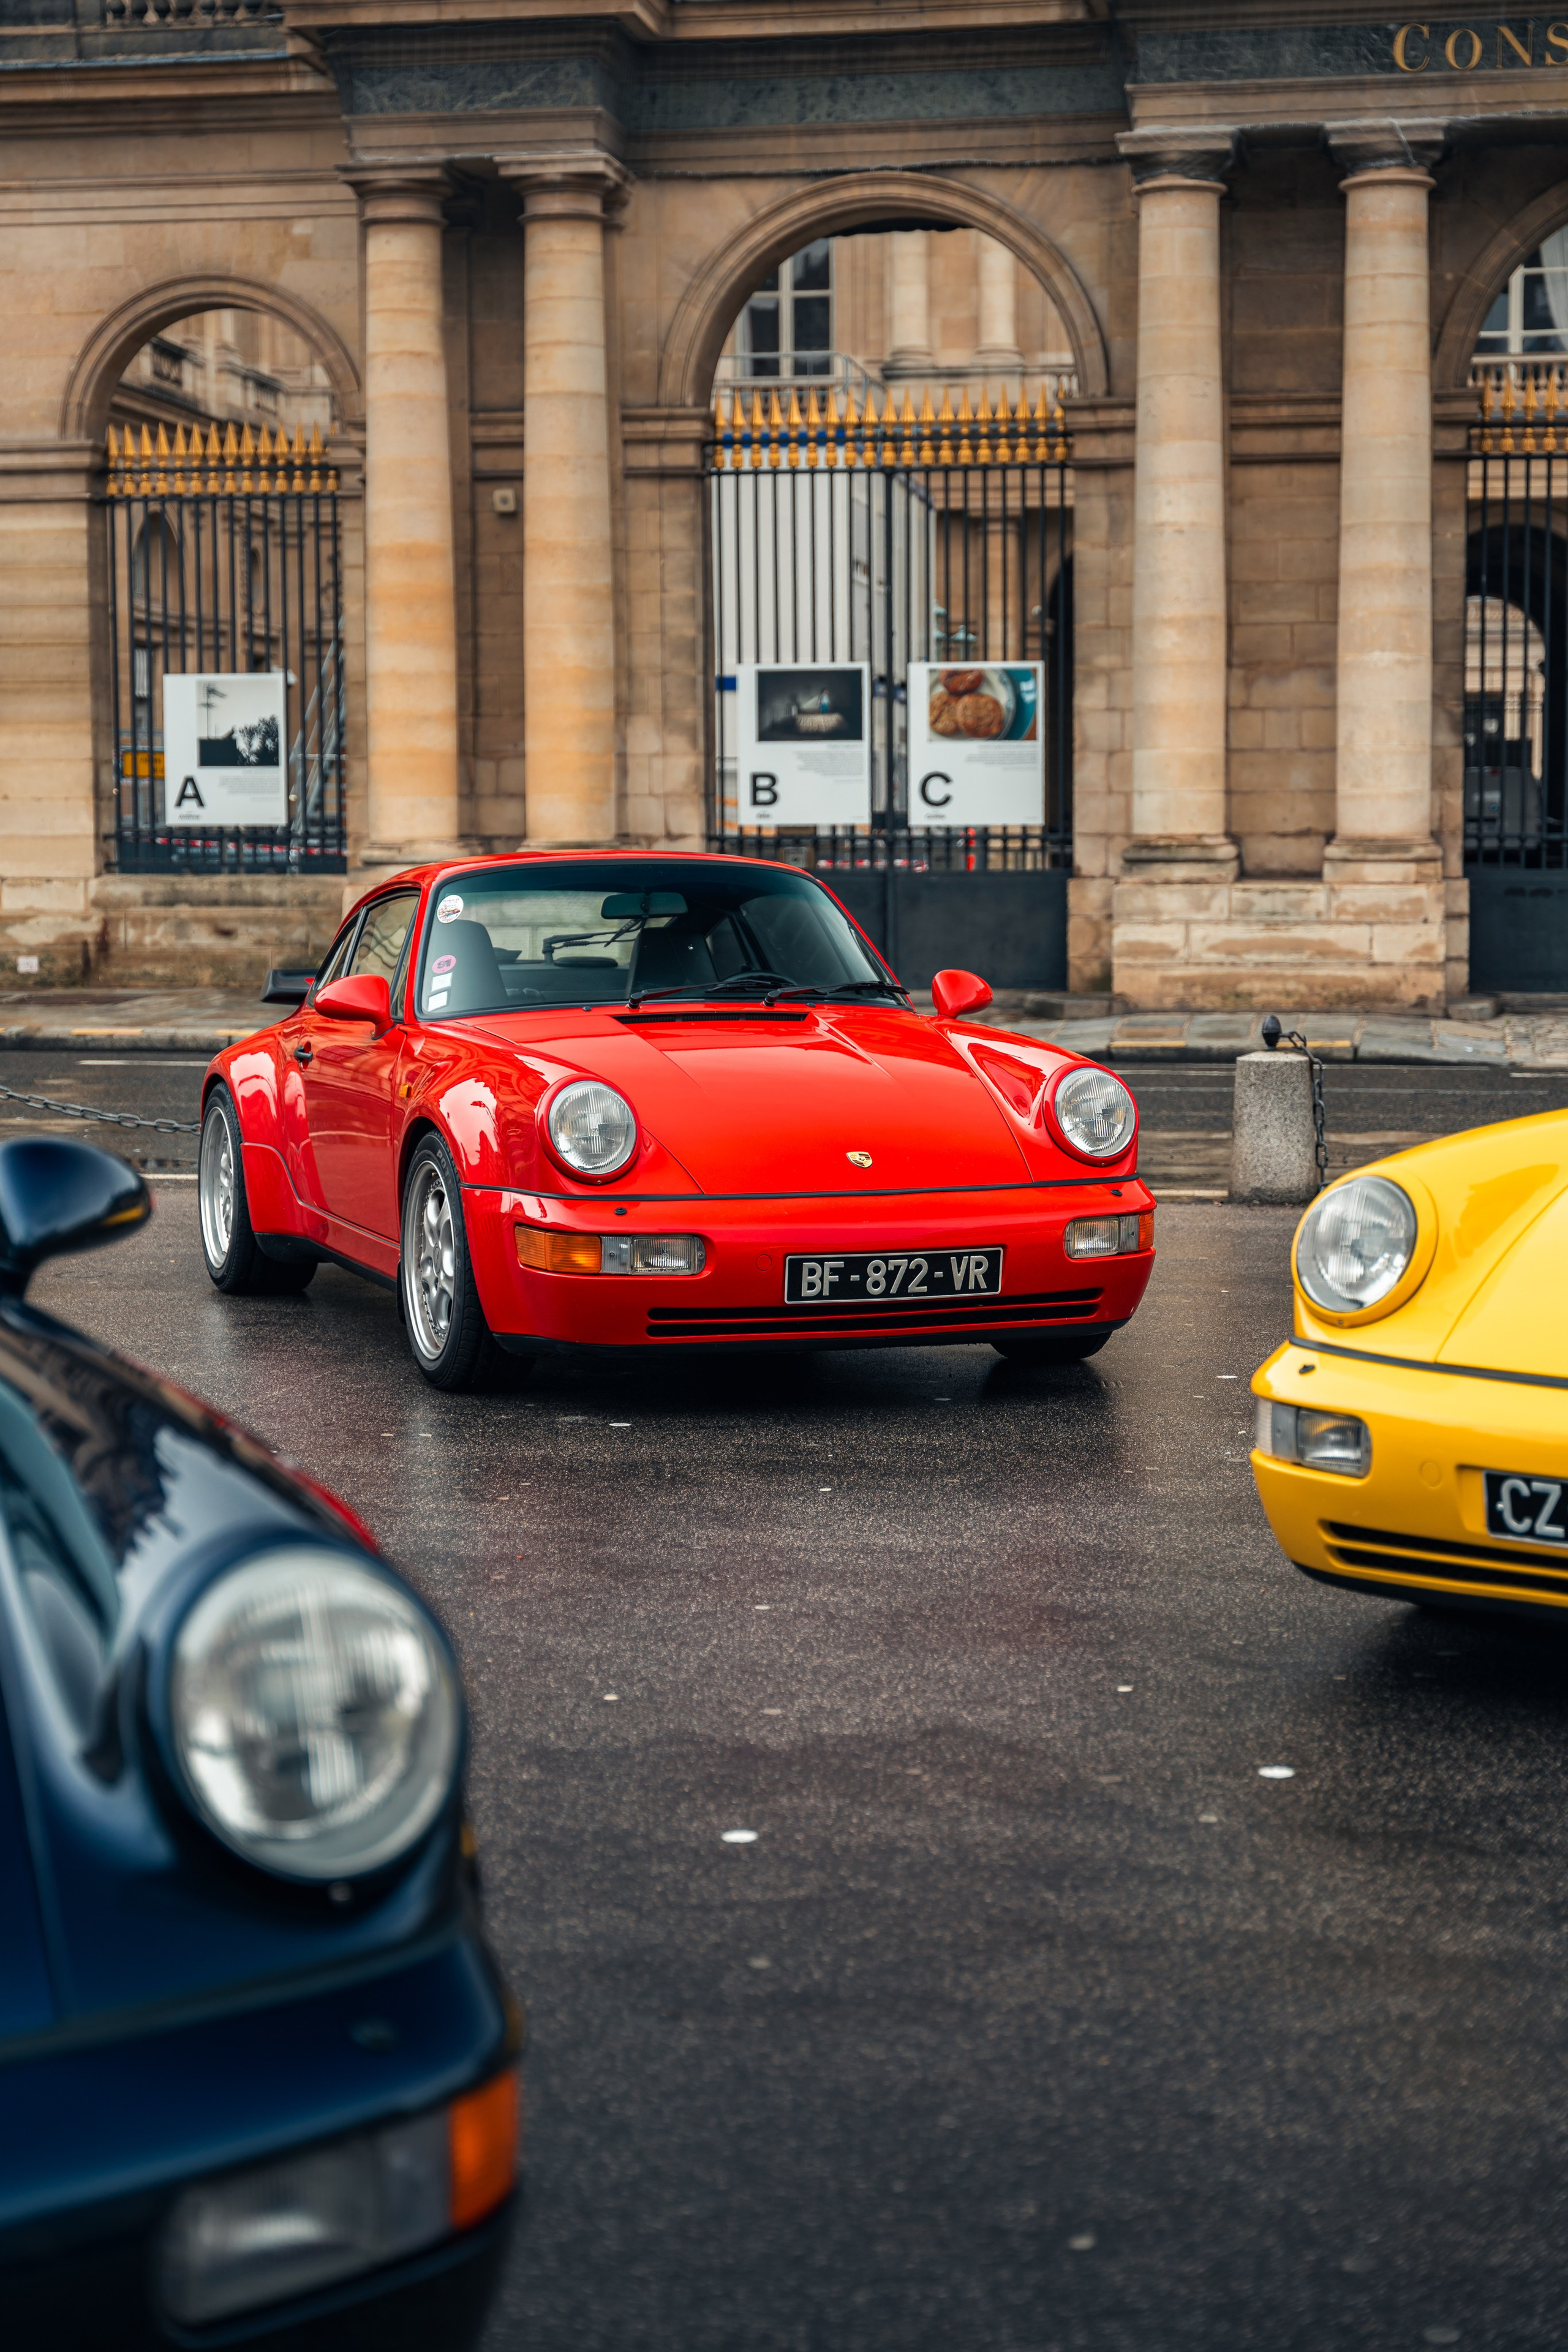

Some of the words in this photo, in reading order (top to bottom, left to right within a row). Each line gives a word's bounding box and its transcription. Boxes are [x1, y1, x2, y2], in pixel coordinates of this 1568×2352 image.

[1393, 22, 1568, 72] CONS
[175, 775, 205, 808] A
[750, 772, 778, 806] B
[921, 772, 952, 807] C
[801, 1256, 989, 1297] BF-872-VR
[1501, 1478, 1566, 1538] CZ
